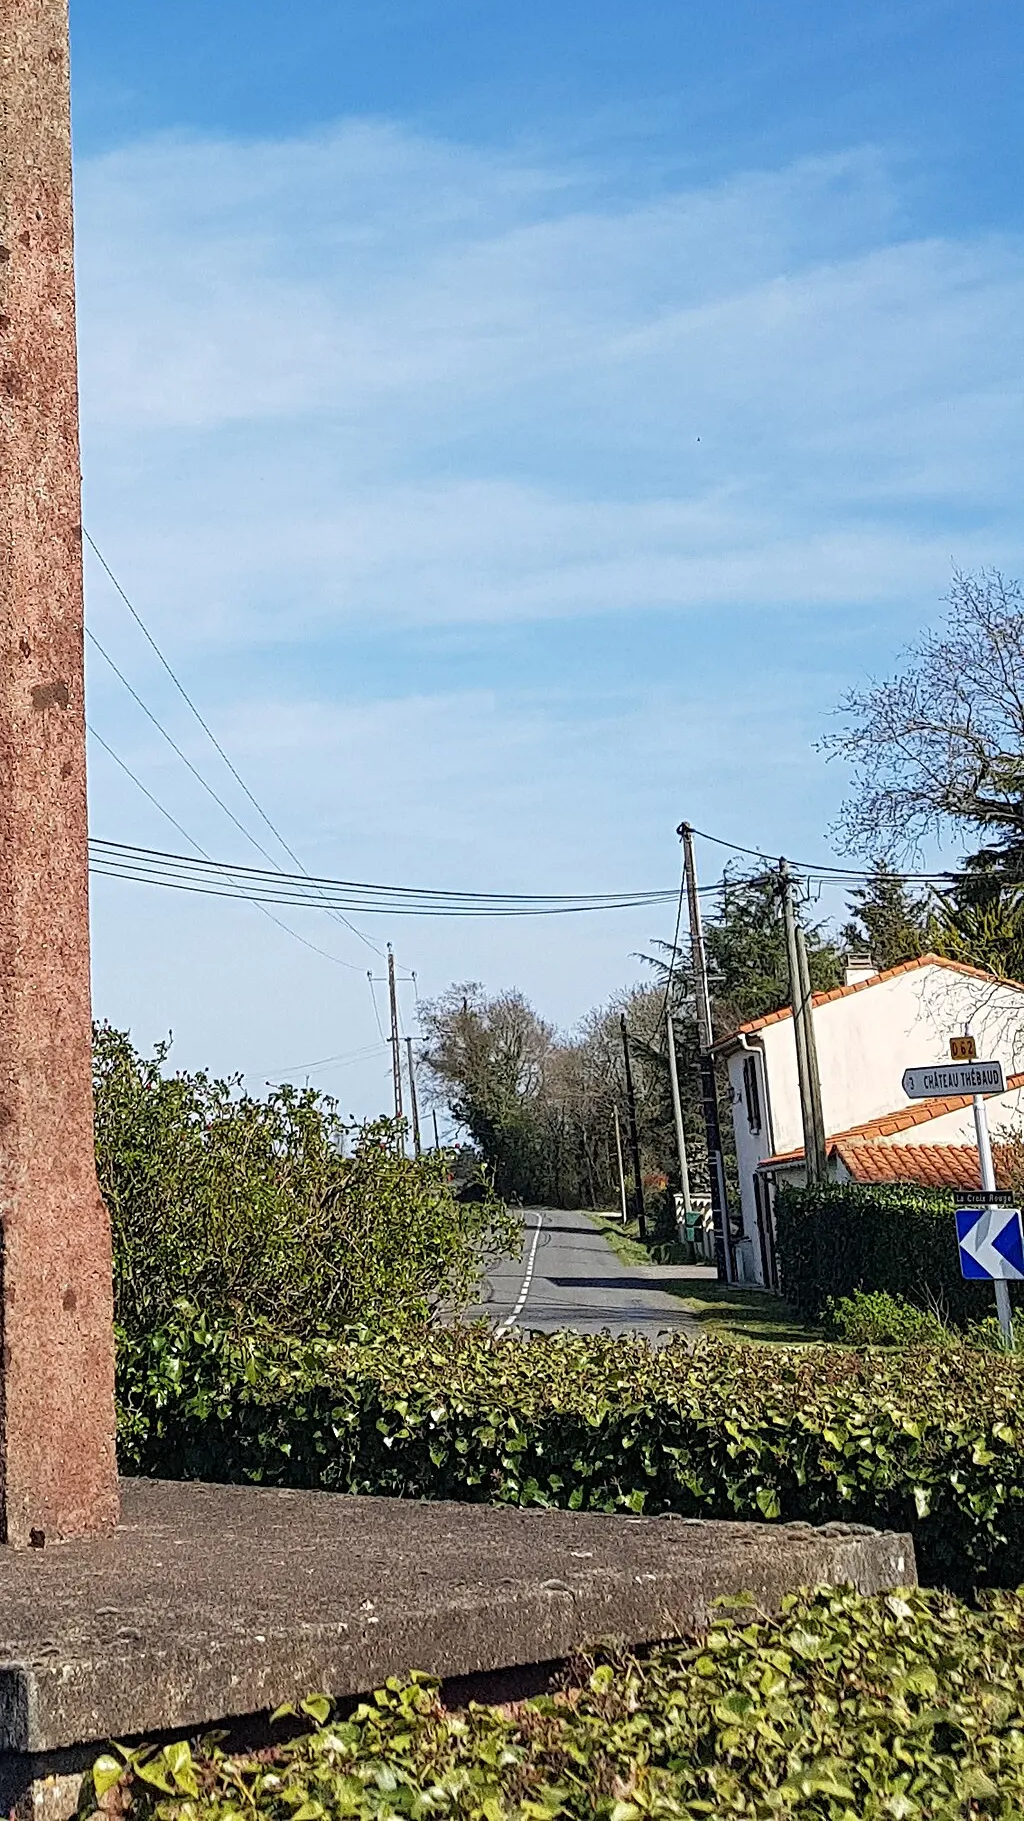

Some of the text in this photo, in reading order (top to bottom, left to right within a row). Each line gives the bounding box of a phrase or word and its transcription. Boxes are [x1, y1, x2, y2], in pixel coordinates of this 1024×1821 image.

[961, 1041, 973, 1055] 62
[908, 1068, 999, 1090] 3 CHÂTEAU THÉBAUD
[989, 1194, 1012, 1204] Rouge
